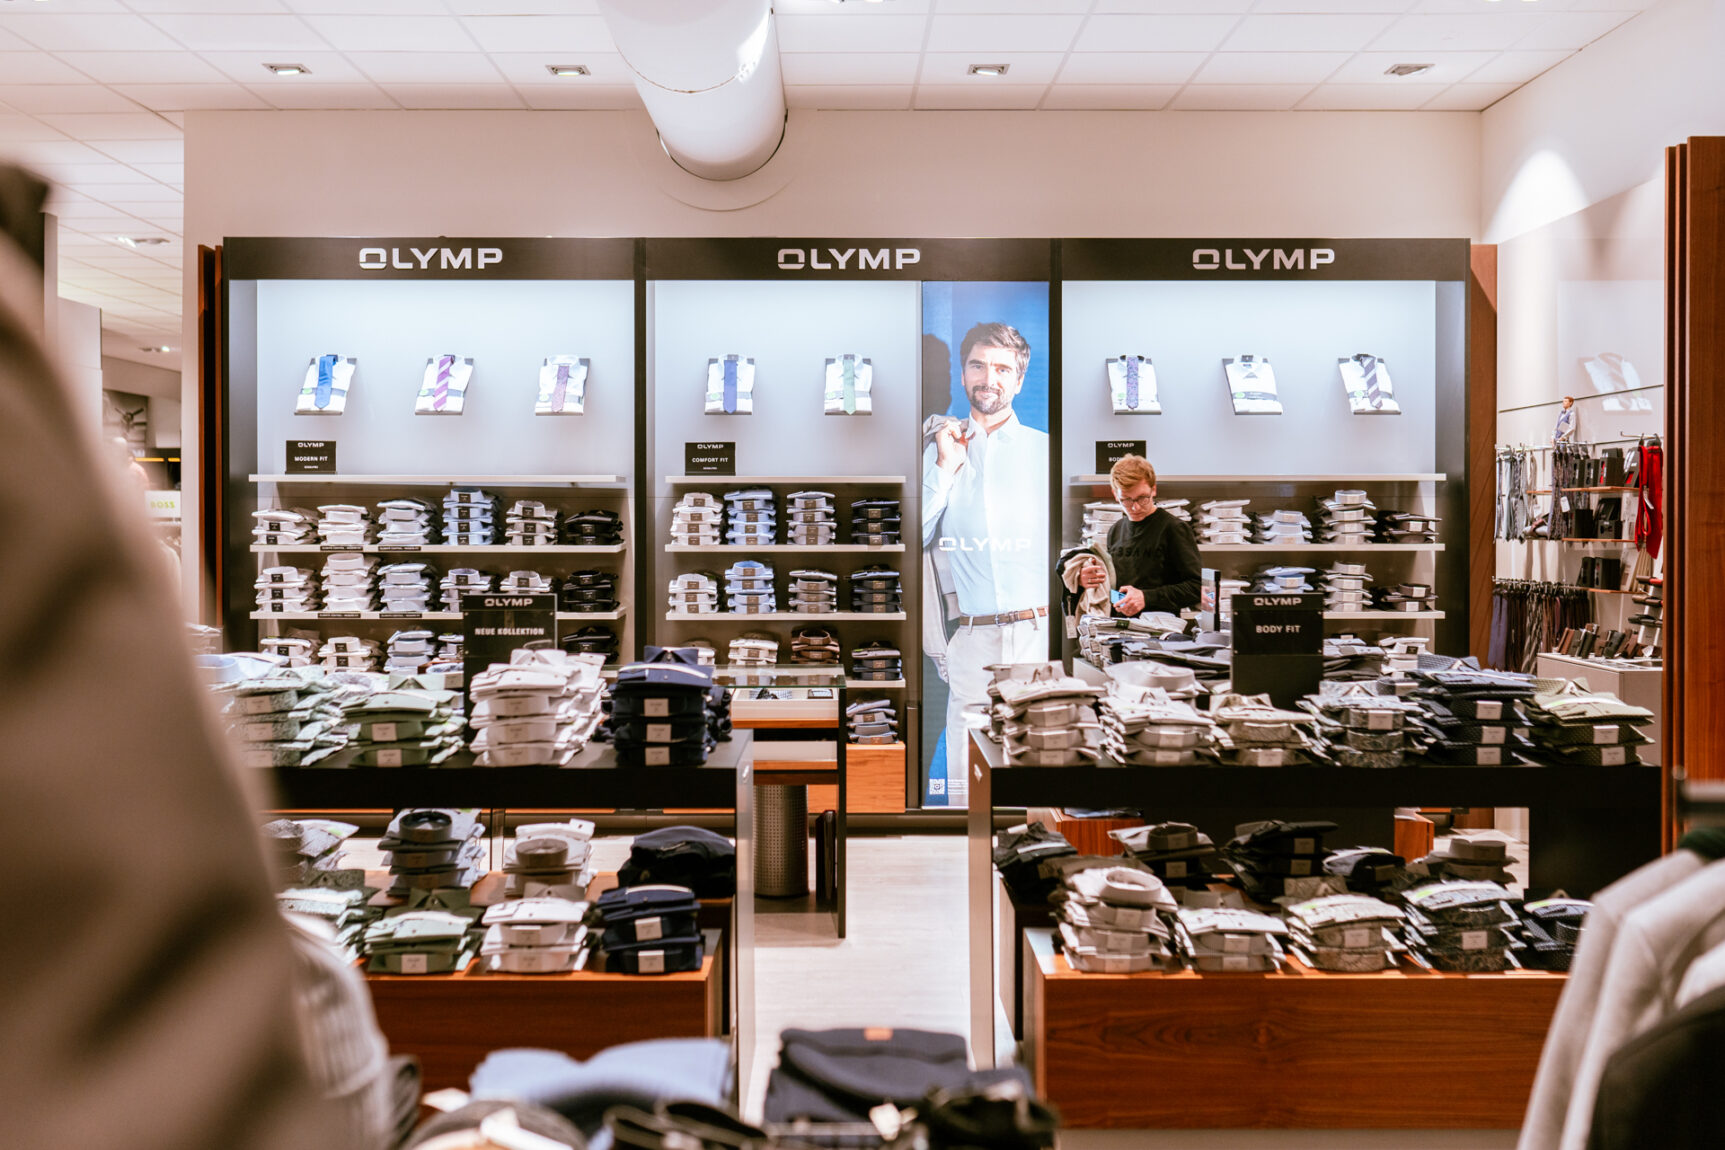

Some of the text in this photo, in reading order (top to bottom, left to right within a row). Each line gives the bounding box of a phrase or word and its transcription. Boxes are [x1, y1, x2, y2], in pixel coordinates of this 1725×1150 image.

[359, 247, 503, 270] OLYMP
[777, 248, 921, 270] OLYMP
[1192, 248, 1335, 270] OLYMP
[939, 537, 1031, 551] OLYMP
[484, 598, 533, 607] OLYMP
[1253, 597, 1302, 606] OLYMP
[497, 628, 544, 636] KOLLEKTION
[1255, 625, 1301, 633] BODY FIT
